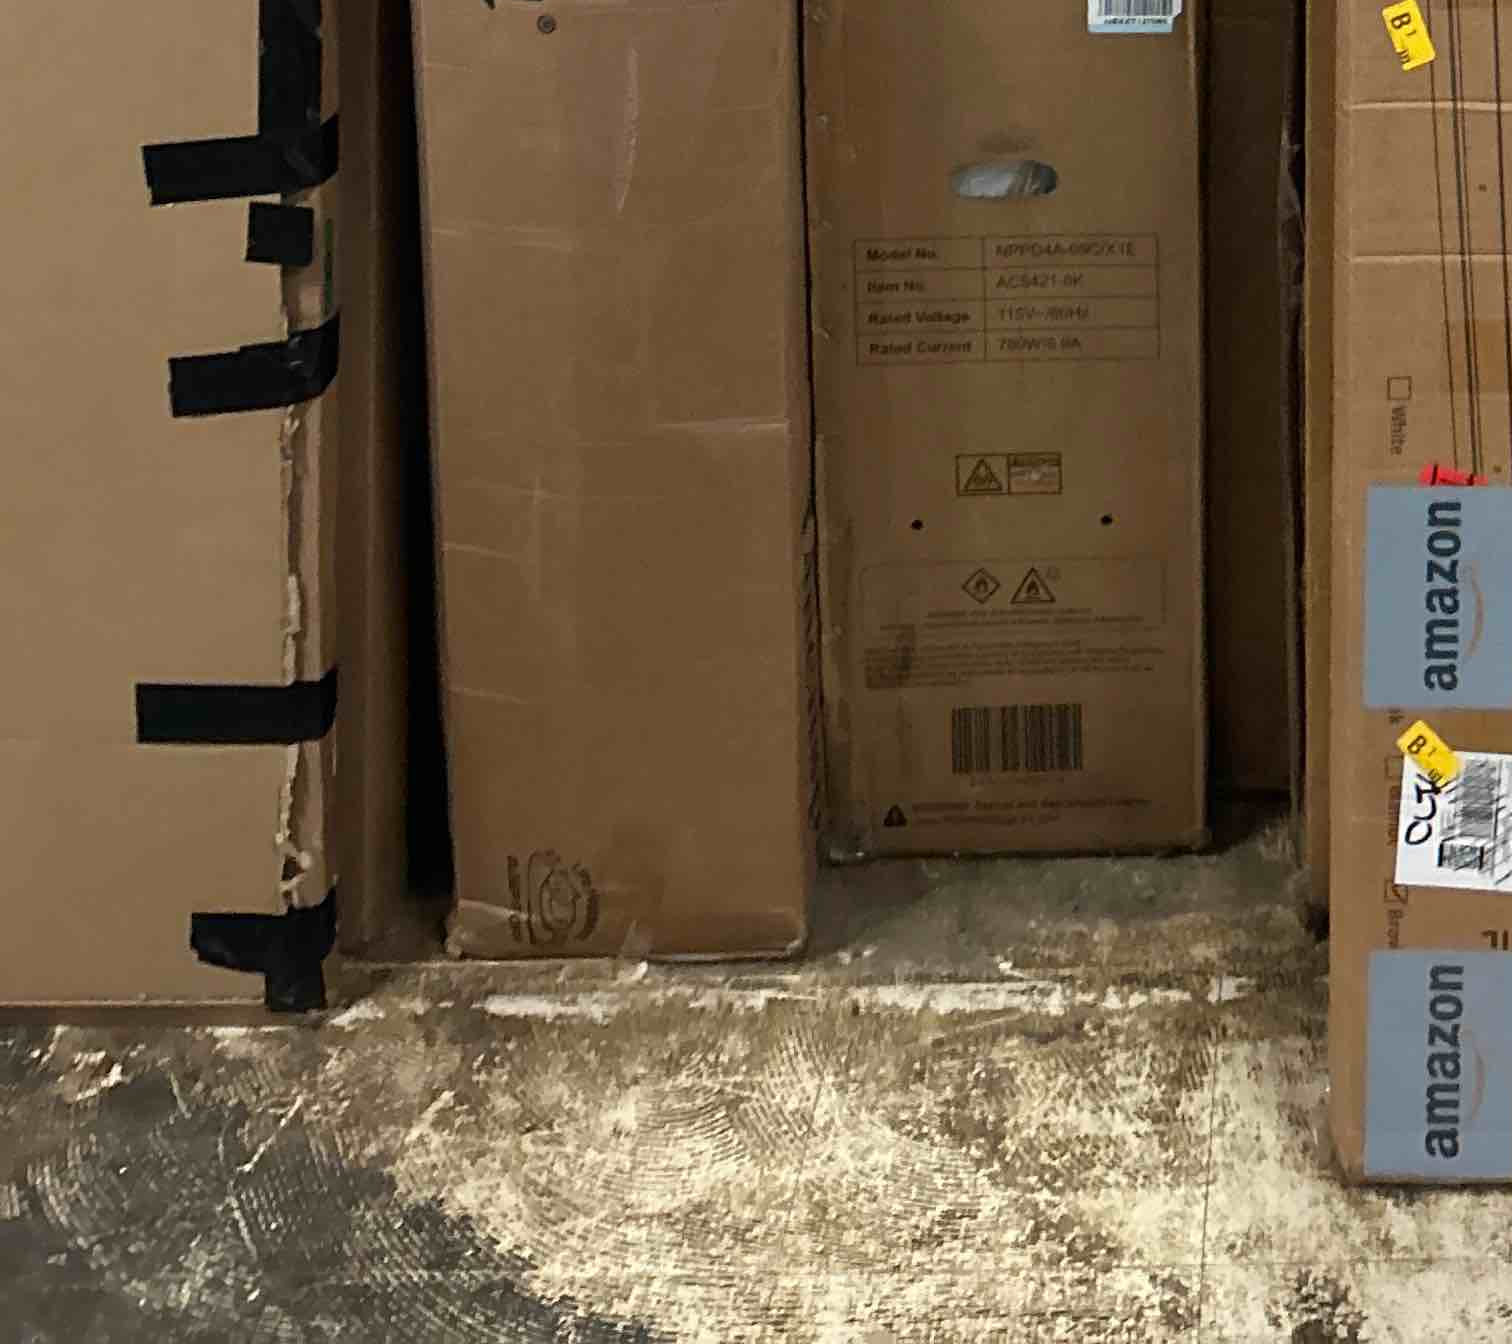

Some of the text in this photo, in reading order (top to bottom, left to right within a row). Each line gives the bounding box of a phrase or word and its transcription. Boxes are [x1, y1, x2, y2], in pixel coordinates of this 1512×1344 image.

[1391, 12, 1411, 29] B
[1424, 499, 1463, 692] amazon
[1407, 735, 1426, 755] B
[1425, 963, 1466, 1162] amazon
